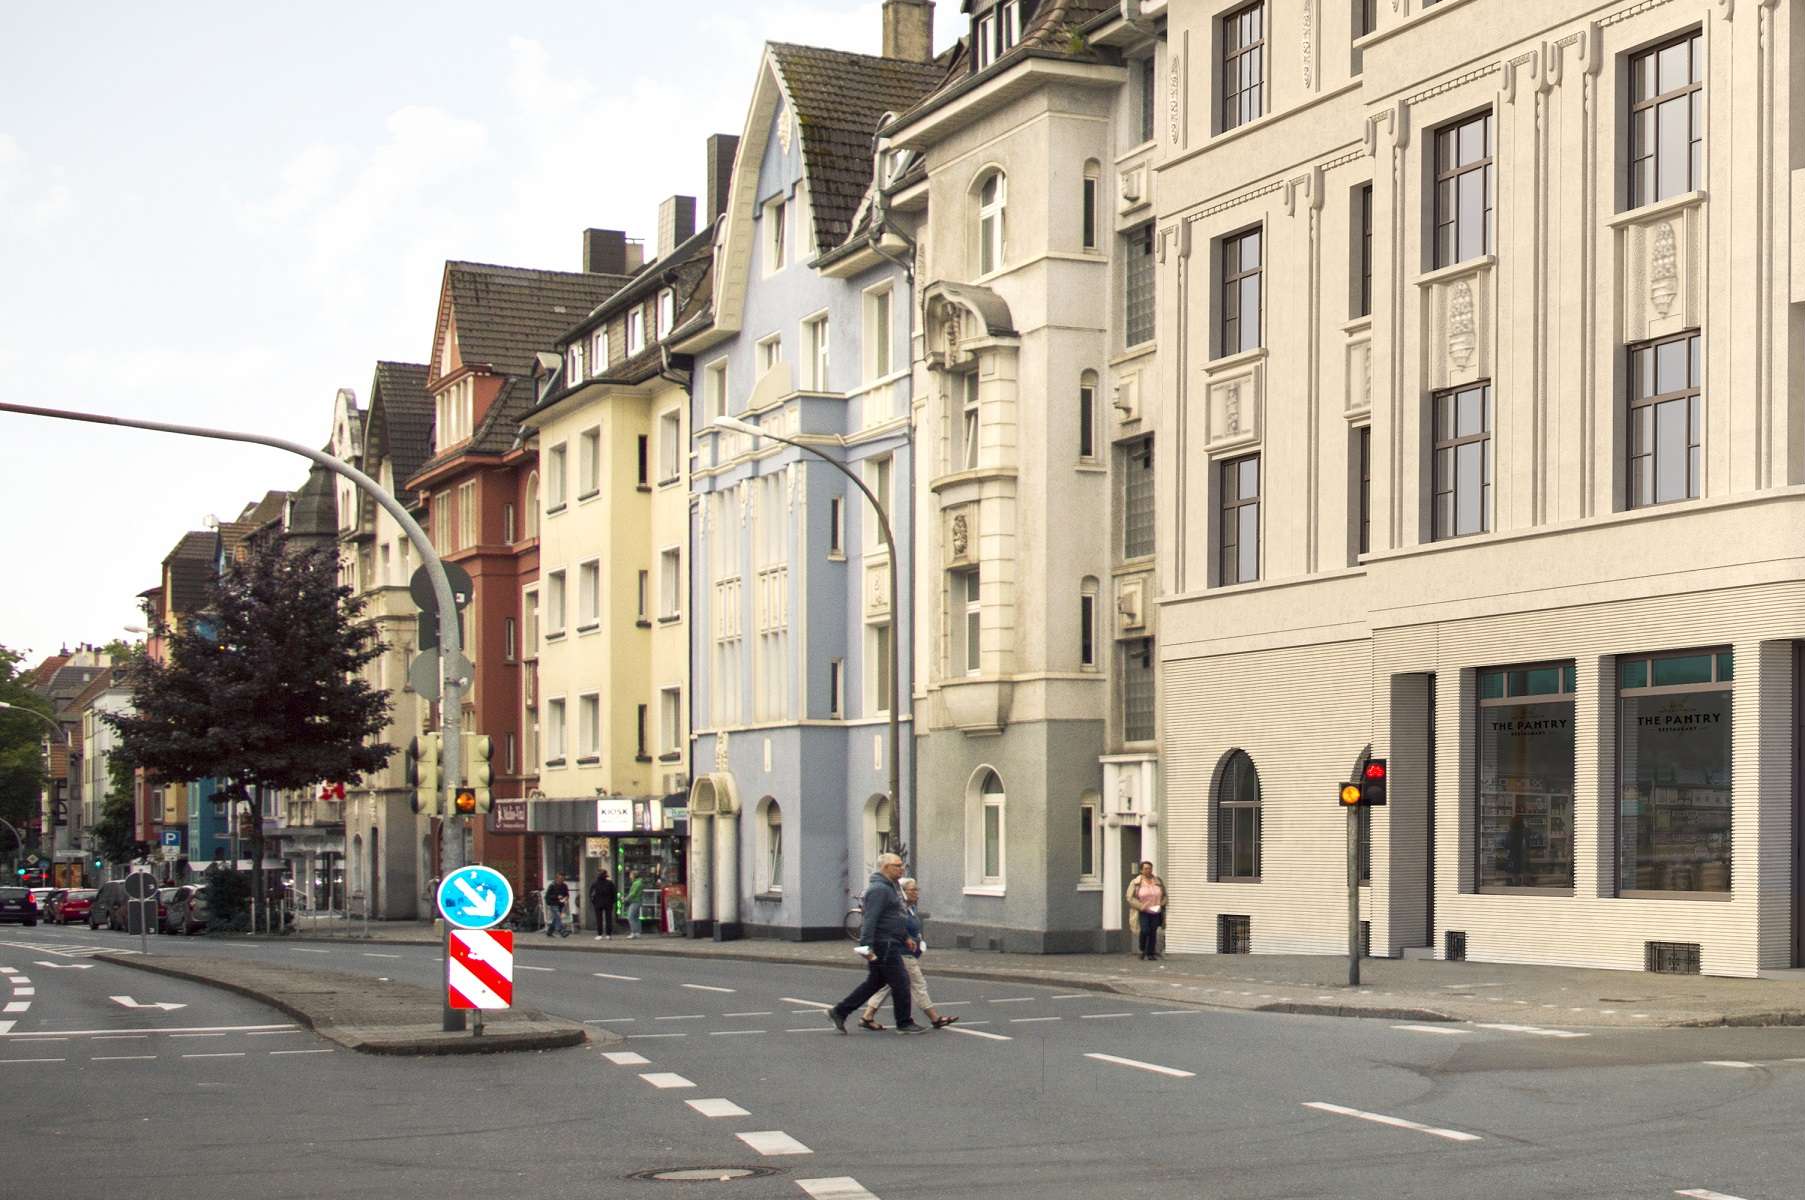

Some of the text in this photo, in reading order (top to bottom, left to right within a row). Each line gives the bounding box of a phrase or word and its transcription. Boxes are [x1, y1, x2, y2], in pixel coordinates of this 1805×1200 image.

[1492, 719, 1567, 731] THE PANTRY
[1638, 712, 1720, 726] THE PANTRY
[165, 832, 177, 845] P
